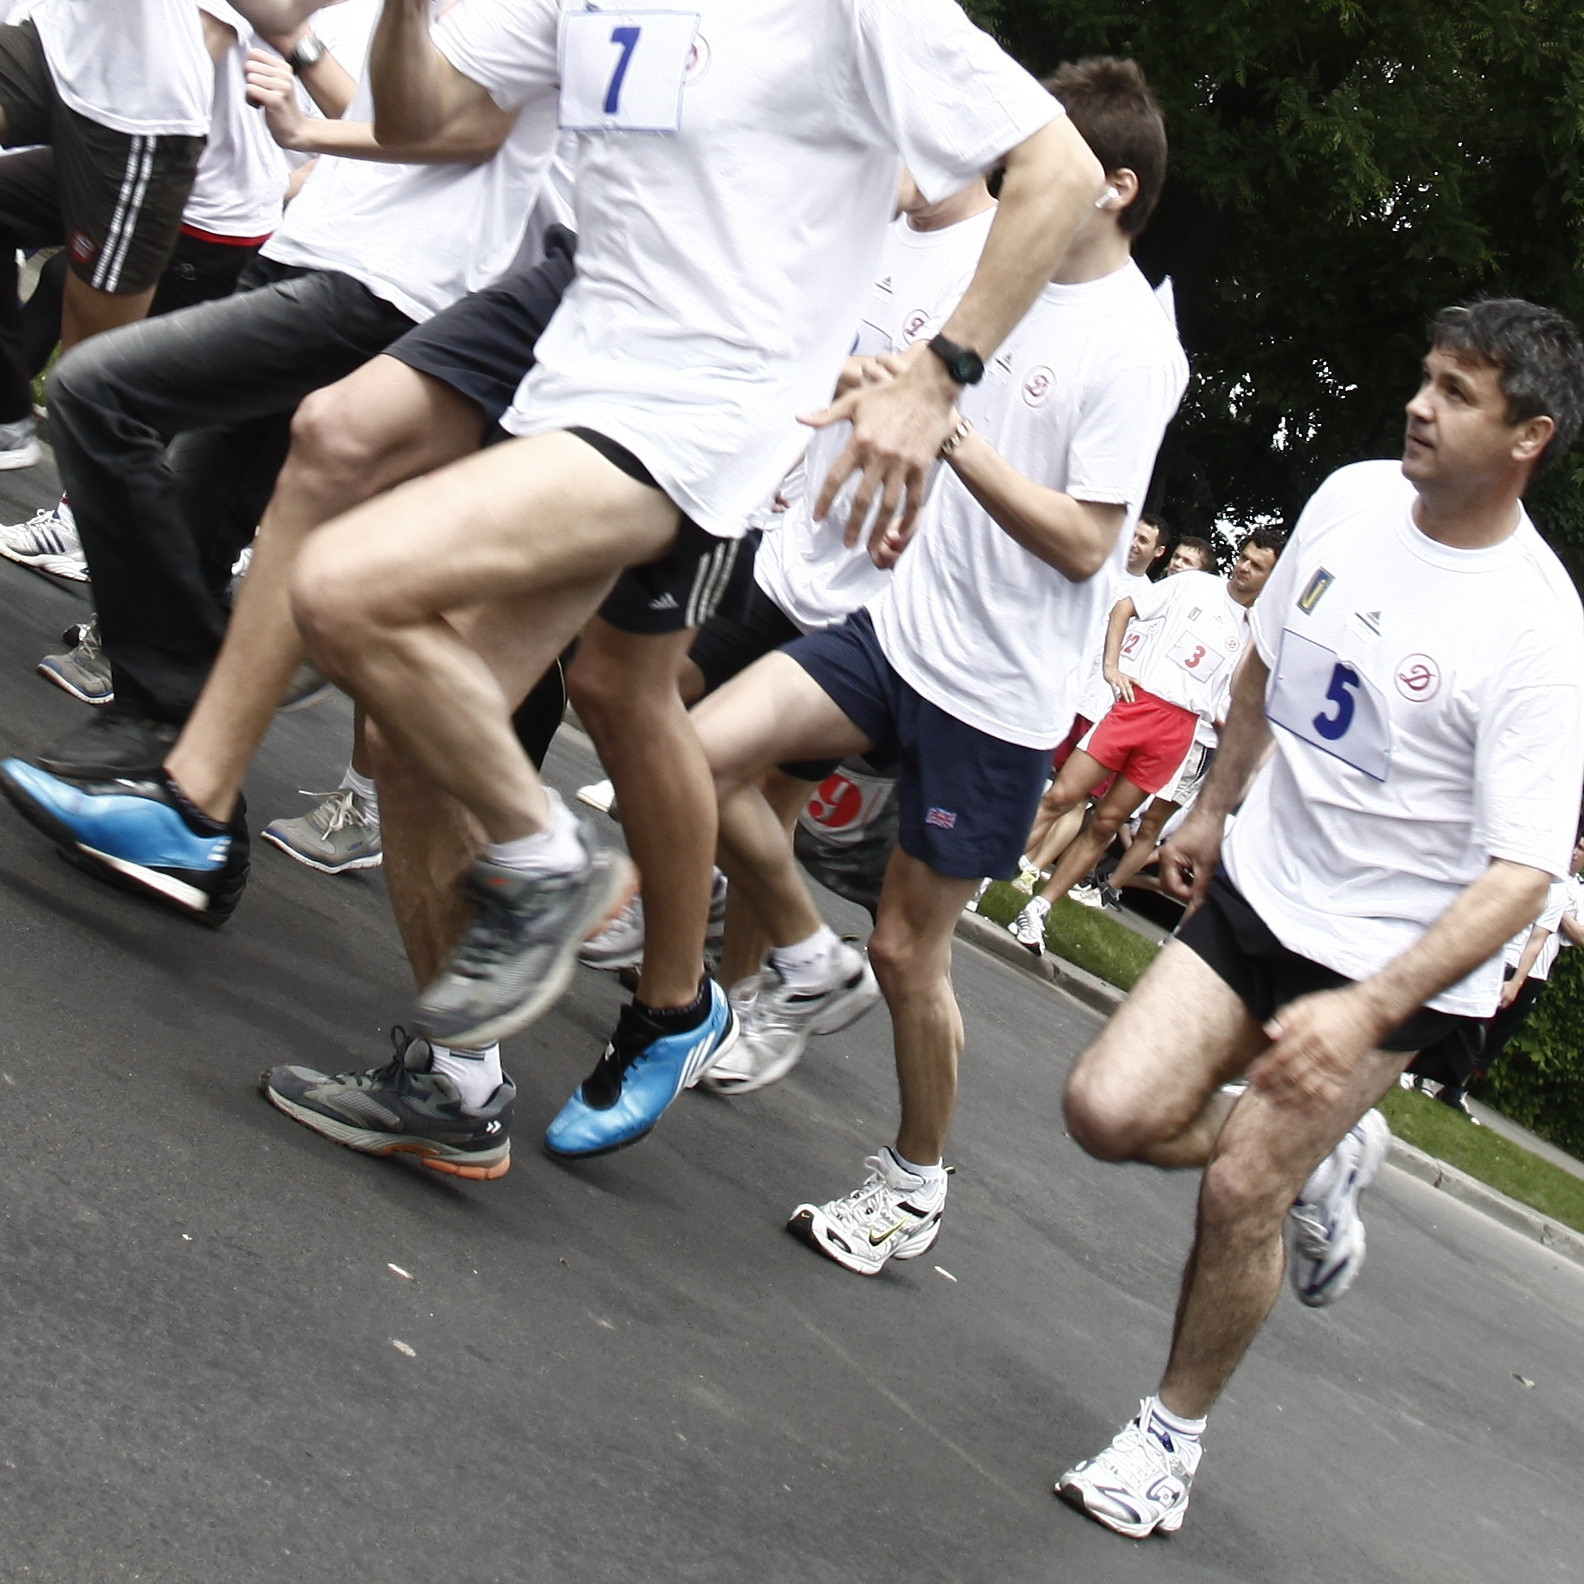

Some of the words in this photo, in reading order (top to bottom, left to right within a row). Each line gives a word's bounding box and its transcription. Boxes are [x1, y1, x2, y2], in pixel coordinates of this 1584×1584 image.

[603, 26, 642, 114] 7
[1184, 644, 1207, 668] 3
[1312, 662, 1360, 741] 5
